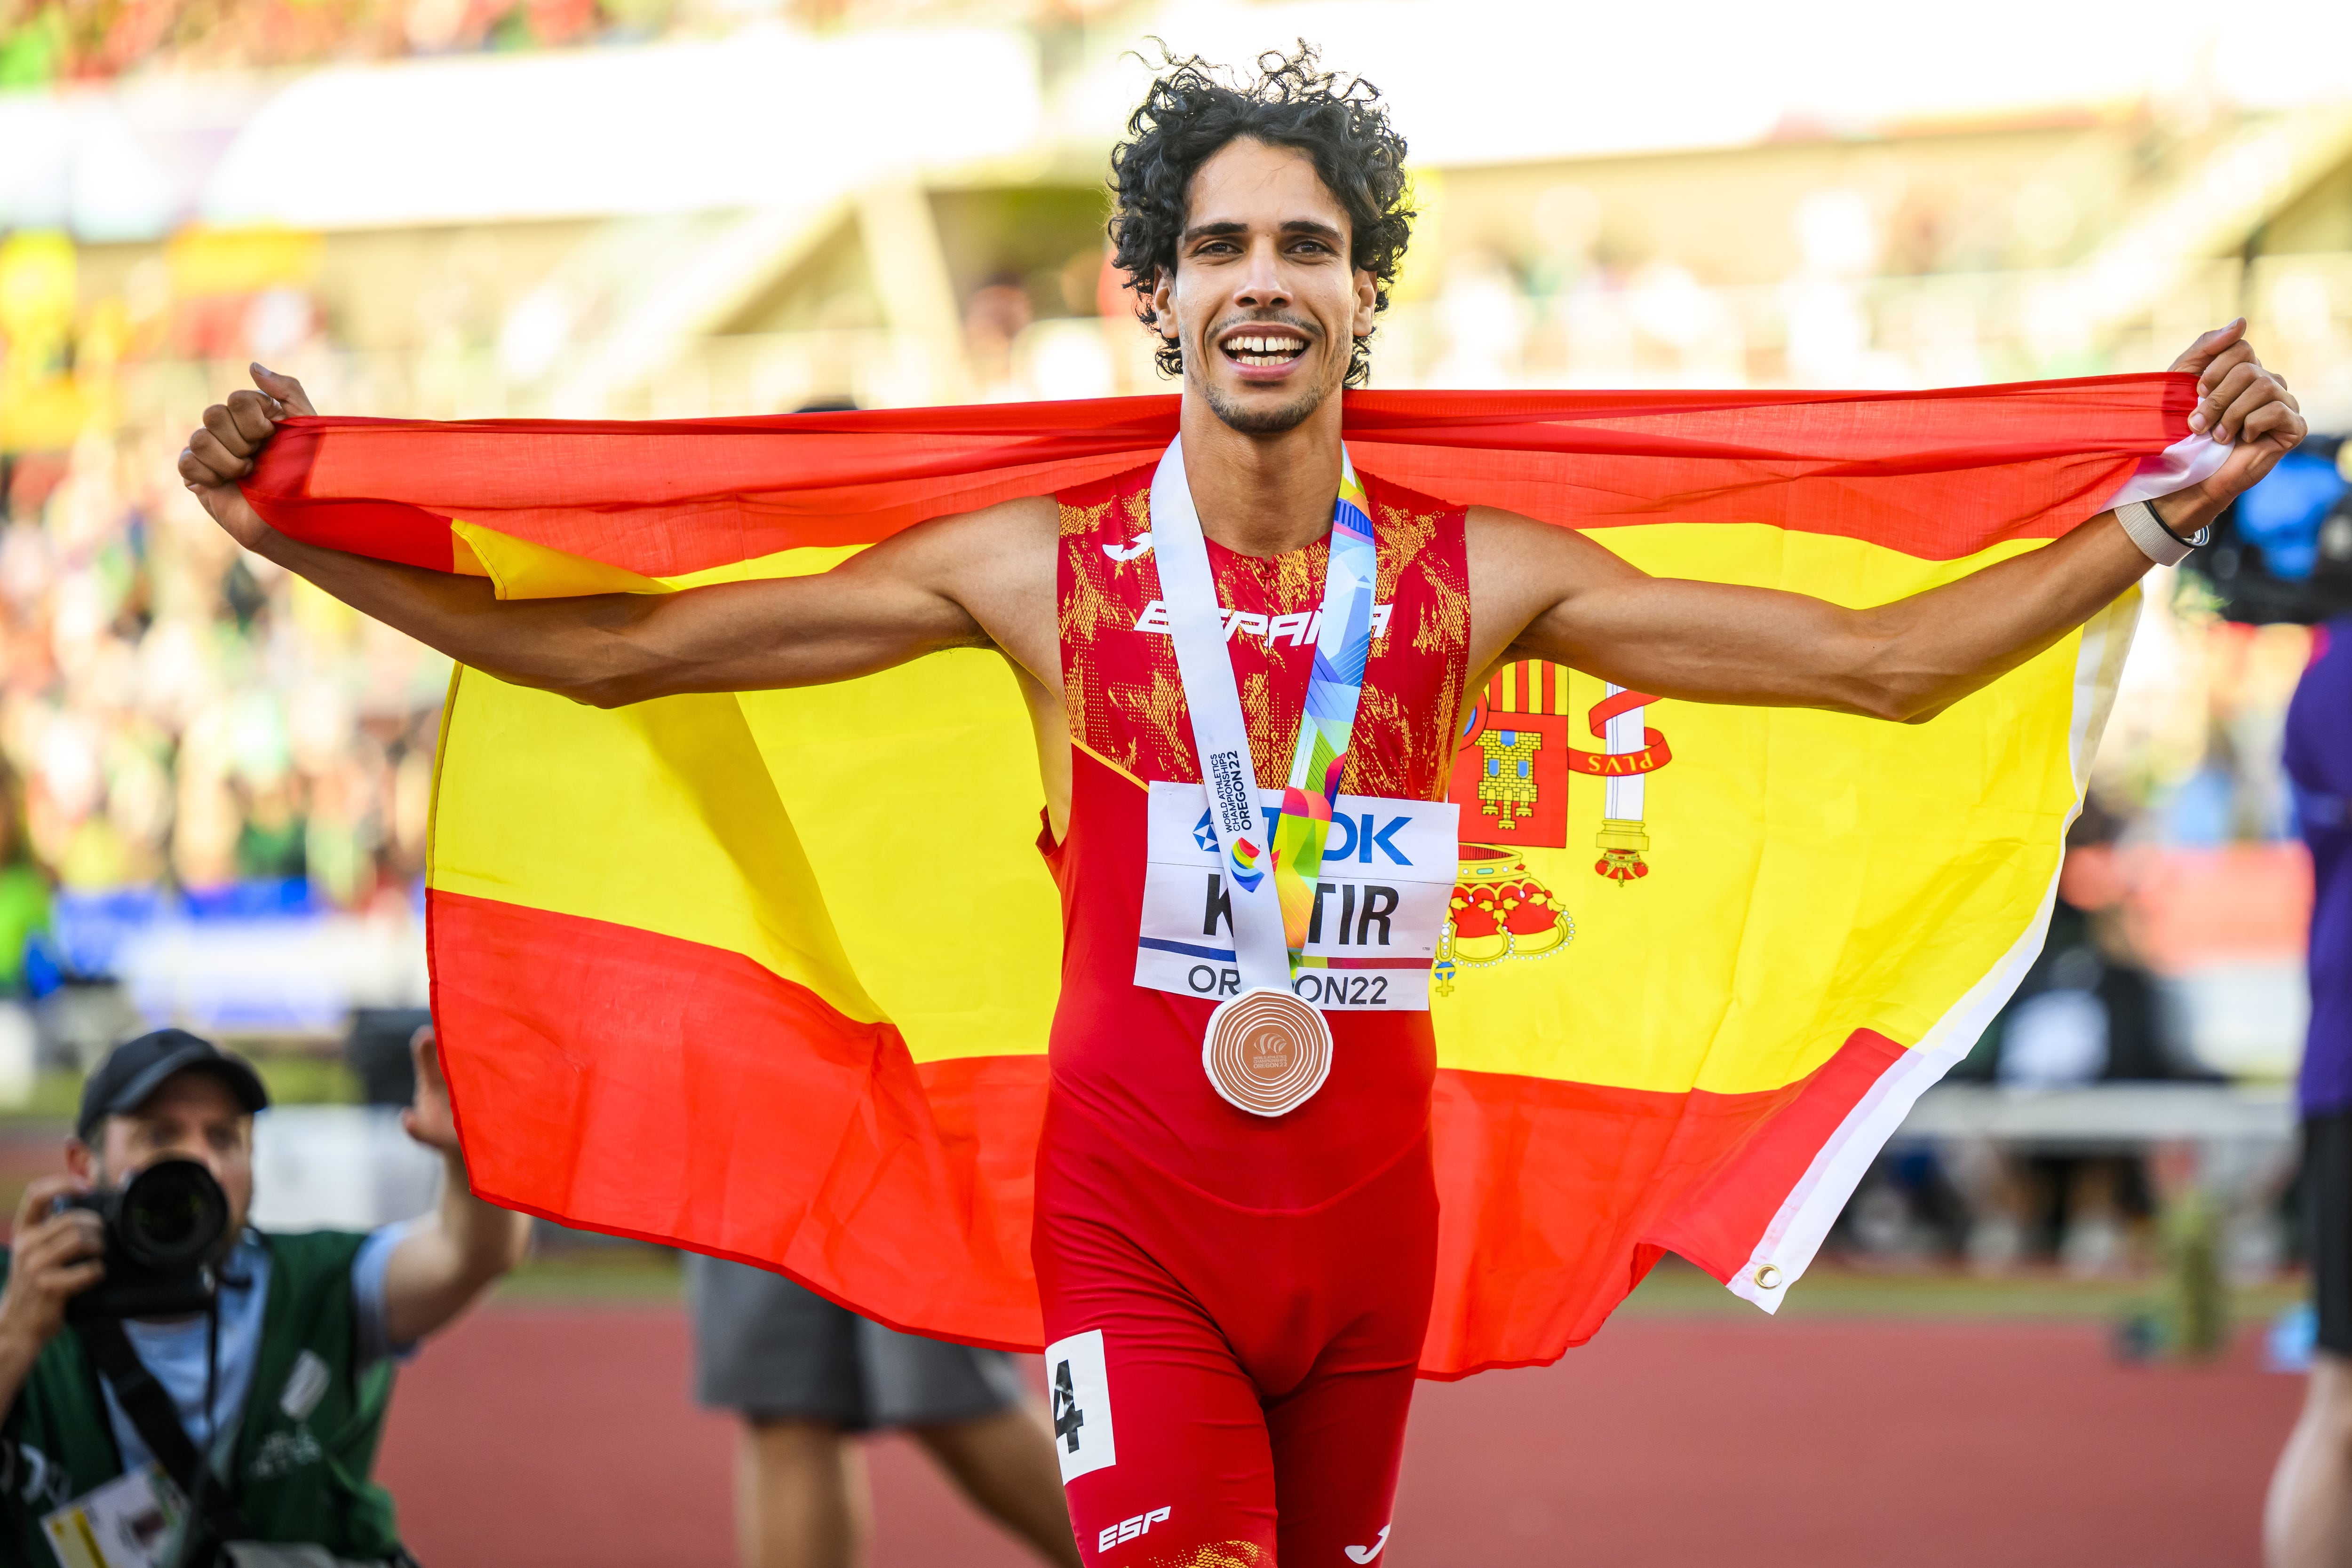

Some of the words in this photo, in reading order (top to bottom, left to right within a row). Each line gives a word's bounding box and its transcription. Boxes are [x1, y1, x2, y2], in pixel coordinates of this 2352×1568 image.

[1210, 754, 1226, 800] ATHLETICS
[1588, 752, 1654, 773] PLVS
[1218, 752, 1241, 832] CHAMPIONSHIPS
[1220, 802, 1233, 833] WORLD
[1202, 873, 1399, 946] KTIR
[1188, 965, 1389, 1005] ORON22
[1053, 1359, 1084, 1454] 4
[1098, 1506, 1171, 1553] ESP
